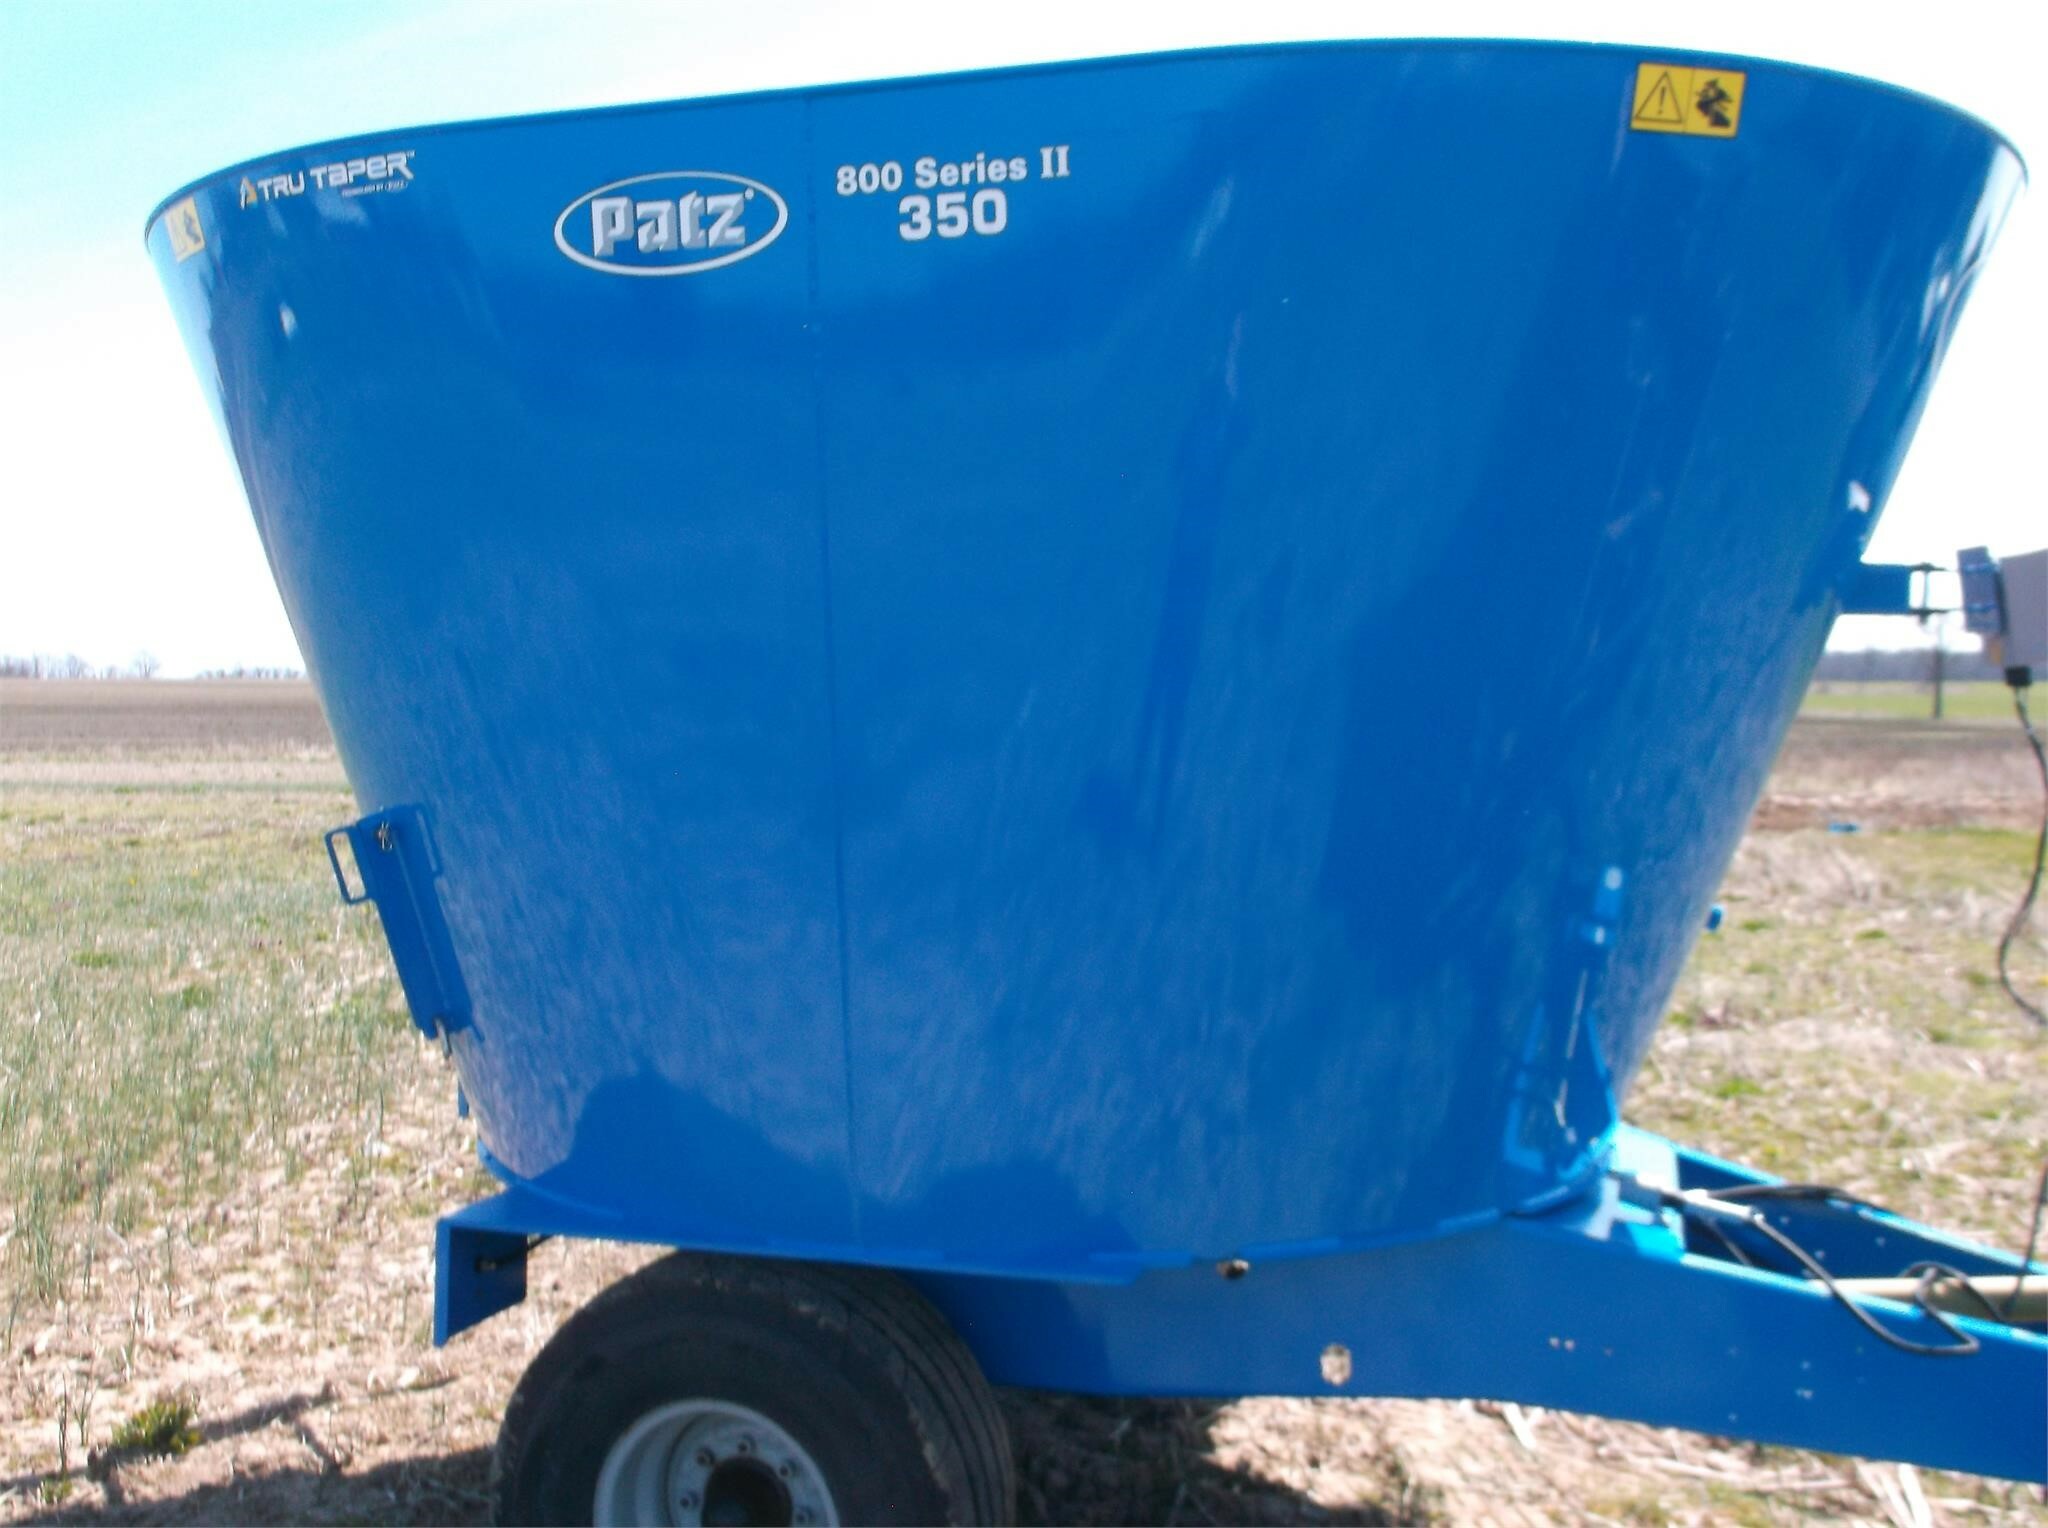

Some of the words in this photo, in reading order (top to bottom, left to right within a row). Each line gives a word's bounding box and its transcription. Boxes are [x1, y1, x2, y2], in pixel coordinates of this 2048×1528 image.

[257, 171, 305, 201] TRU
[836, 162, 902, 196] 800
[915, 153, 1028, 189] Series
[1040, 145, 1070, 178] II
[591, 190, 747, 257] Patz
[899, 188, 1008, 241] 350
